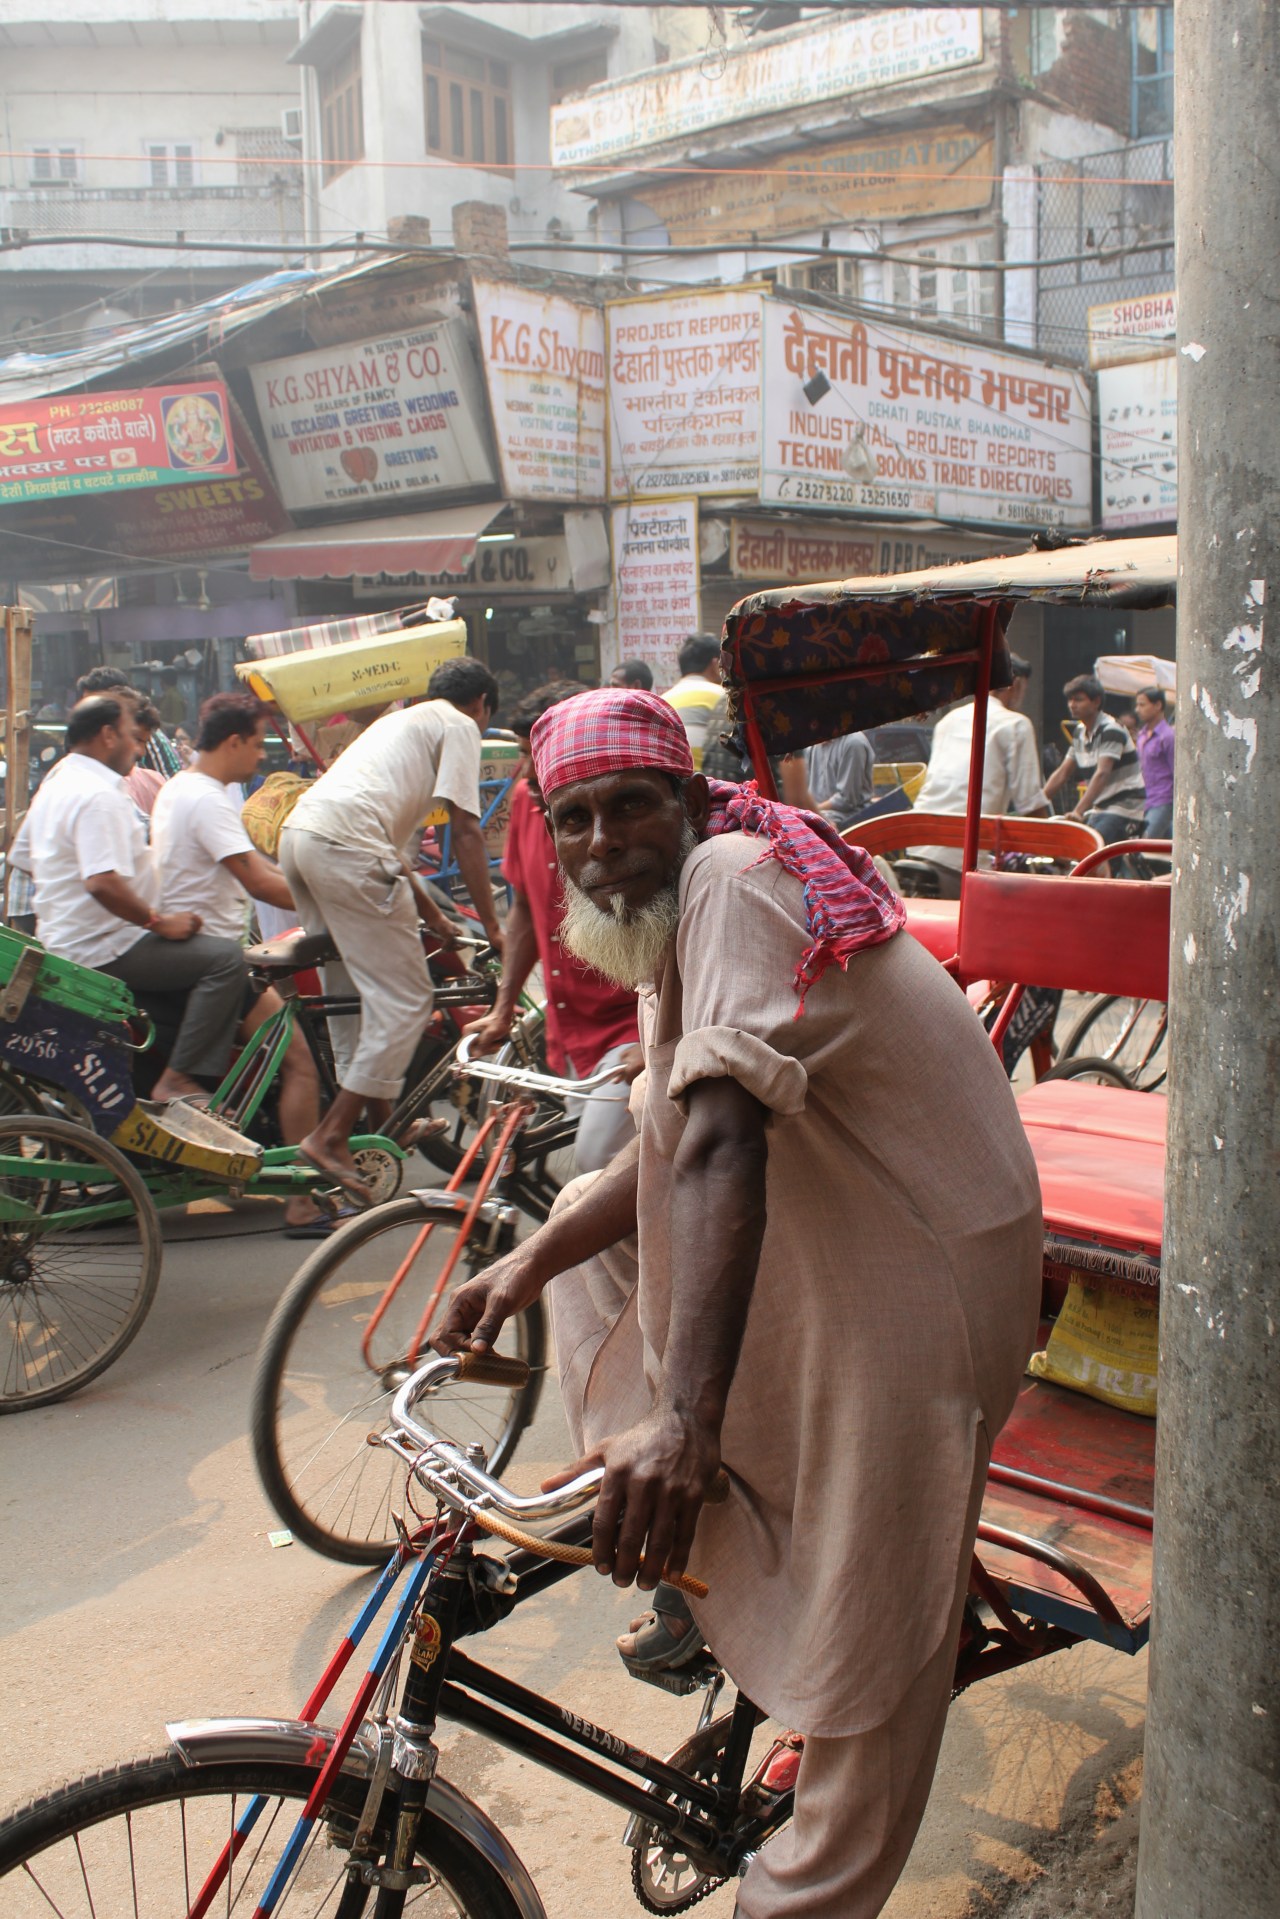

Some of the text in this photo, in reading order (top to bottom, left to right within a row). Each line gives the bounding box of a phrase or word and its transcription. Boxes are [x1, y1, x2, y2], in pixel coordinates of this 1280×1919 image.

[816, 59, 921, 92] INDUSTRIES
[928, 45, 976, 66] LTD.
[1113, 298, 1174, 323] SHOBHA
[616, 319, 685, 344] PROJECT
[385, 352, 401, 384] &
[406, 346, 447, 380] CO.
[662, 344, 715, 388] पुस्तक
[783, 310, 869, 387] देहाती
[876, 344, 975, 404] पुस्तक
[50, 405, 77, 419] PH.
[271, 390, 460, 440] ALL OCCASION GREETINGS WEDDING
[364, 388, 397, 404] FANCY
[288, 432, 342, 456] INVITATION
[356, 419, 404, 443] VISITING
[407, 413, 448, 435] CARDS
[868, 400, 1032, 442] DEHATI PUSTAK BHANDHAR
[73, 453, 108, 469] पर
[384, 446, 439, 468] GREETINGS
[789, 411, 895, 449] INDUSTIAL
[906, 429, 978, 461] PROJECT
[987, 442, 1057, 473] REPORTS
[154, 478, 265, 513] SWEETS
[932, 461, 976, 488] TRADE
[980, 467, 1073, 499] DIRECTORIES
[481, 550, 496, 582] &
[499, 547, 535, 582] CO.
[736, 528, 786, 573] देहाती
[785, 536, 835, 577] पुस्तक
[560, 1708, 627, 1757] NEELAM
